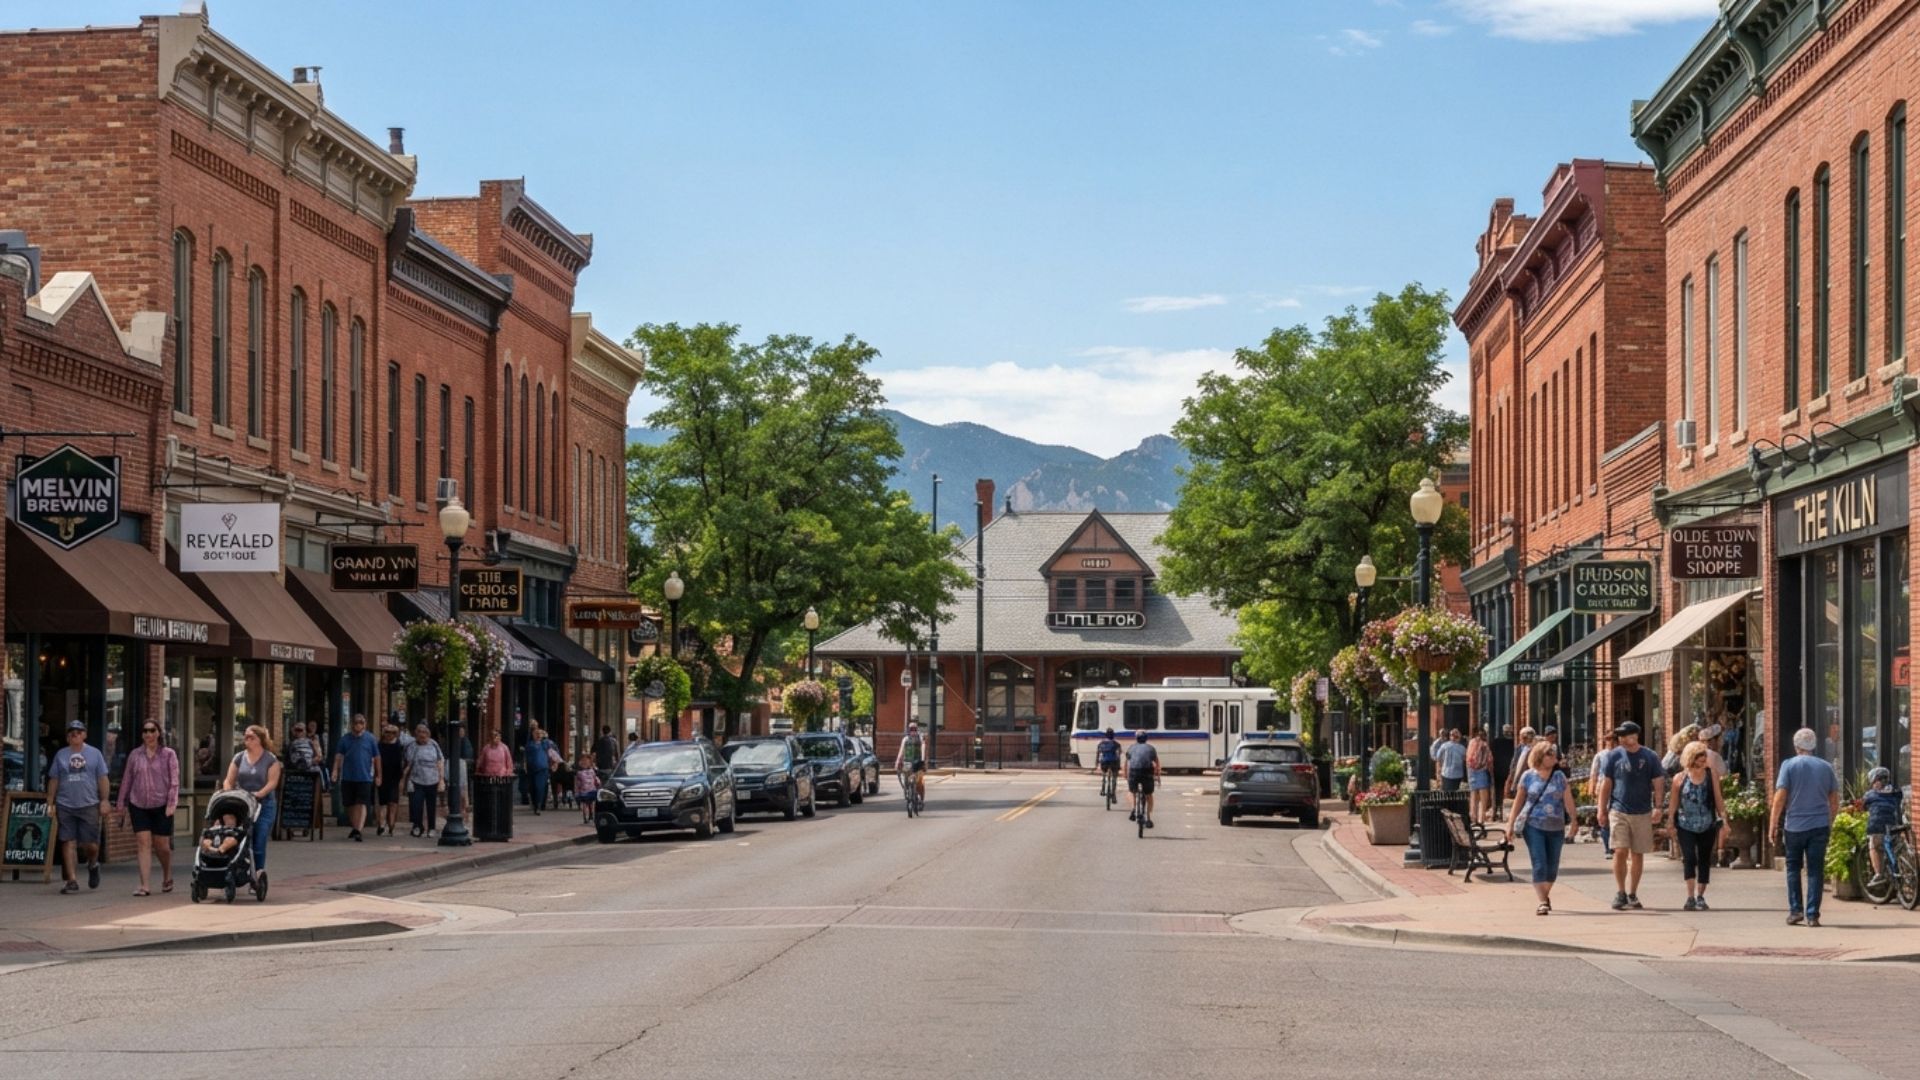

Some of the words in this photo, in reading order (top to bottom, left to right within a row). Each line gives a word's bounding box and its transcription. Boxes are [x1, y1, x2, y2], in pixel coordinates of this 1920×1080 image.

[21, 477, 113, 498] MELVIN
[26, 498, 109, 513] BREWING
[1793, 490, 1828, 544] THE
[1833, 473, 1876, 536] KILN
[186, 533, 274, 548] REVEALED
[1672, 529, 1710, 543] OLDE
[333, 556, 386, 570] GRAND
[390, 556, 417, 570] VIN
[1579, 567, 1647, 581] HUDSON
